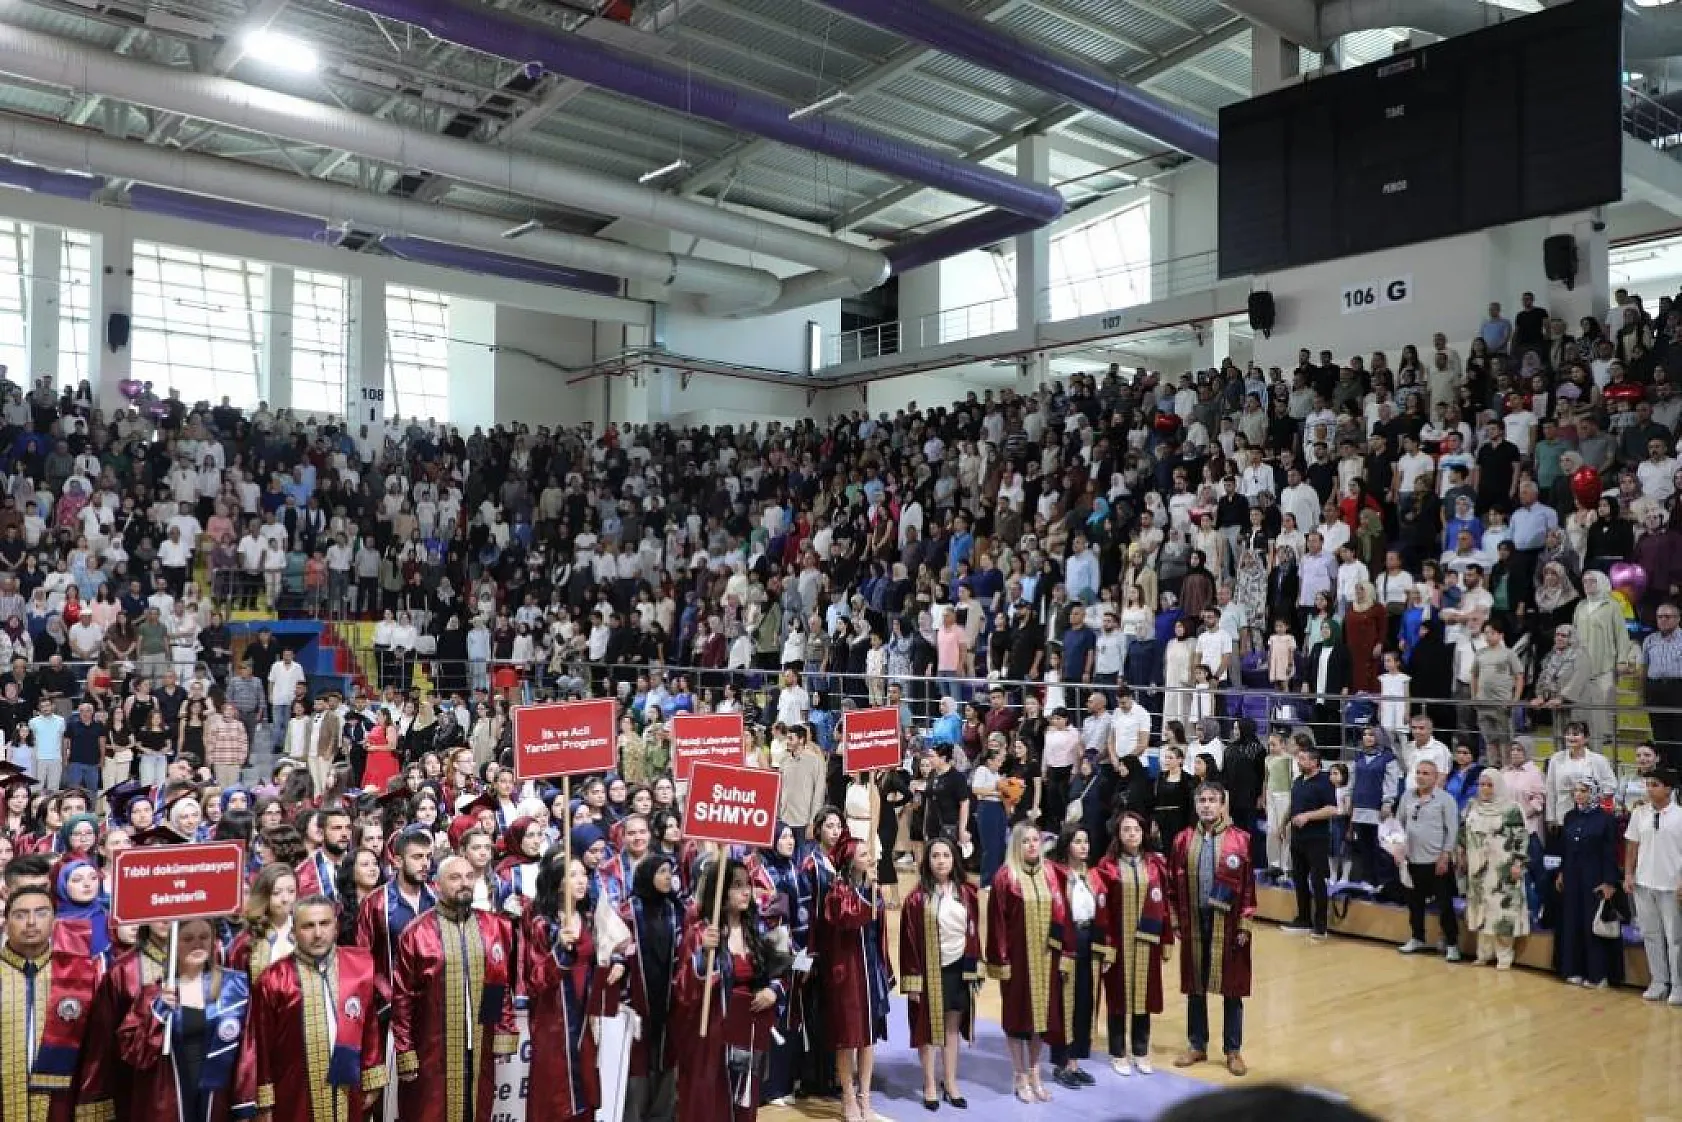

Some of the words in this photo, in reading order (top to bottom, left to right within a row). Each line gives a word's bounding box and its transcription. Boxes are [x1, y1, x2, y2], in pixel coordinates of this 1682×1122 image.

[1344, 286, 1375, 309] 106
[1387, 280, 1407, 302] G
[1101, 315, 1122, 330] 107
[361, 387, 384, 402] 108
[712, 783, 757, 805] Şuhut
[694, 801, 769, 828] SHMYO
